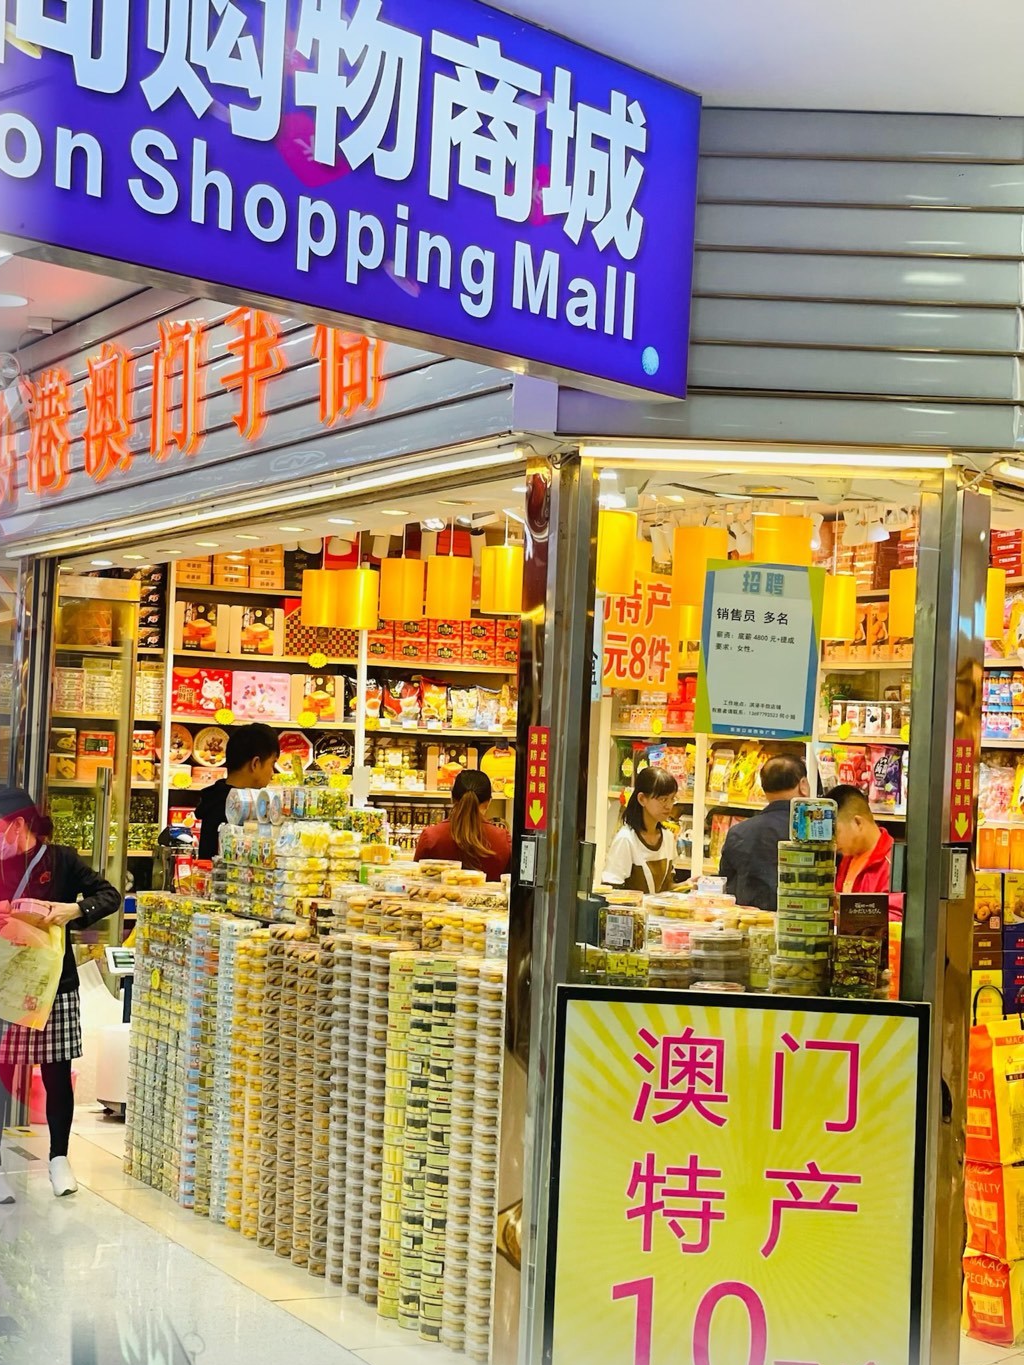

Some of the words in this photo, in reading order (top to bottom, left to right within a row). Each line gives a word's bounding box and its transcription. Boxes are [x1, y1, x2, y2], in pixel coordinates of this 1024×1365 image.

[128, 128, 495, 318] Shopping
[512, 241, 636, 342] Mall
[716, 607, 756, 623] 销售员
[764, 611, 788, 626] 多名
[742, 570, 786, 597] 招聘
[632, 1027, 860, 1133] 澳门
[625, 1152, 862, 1259] 特产
